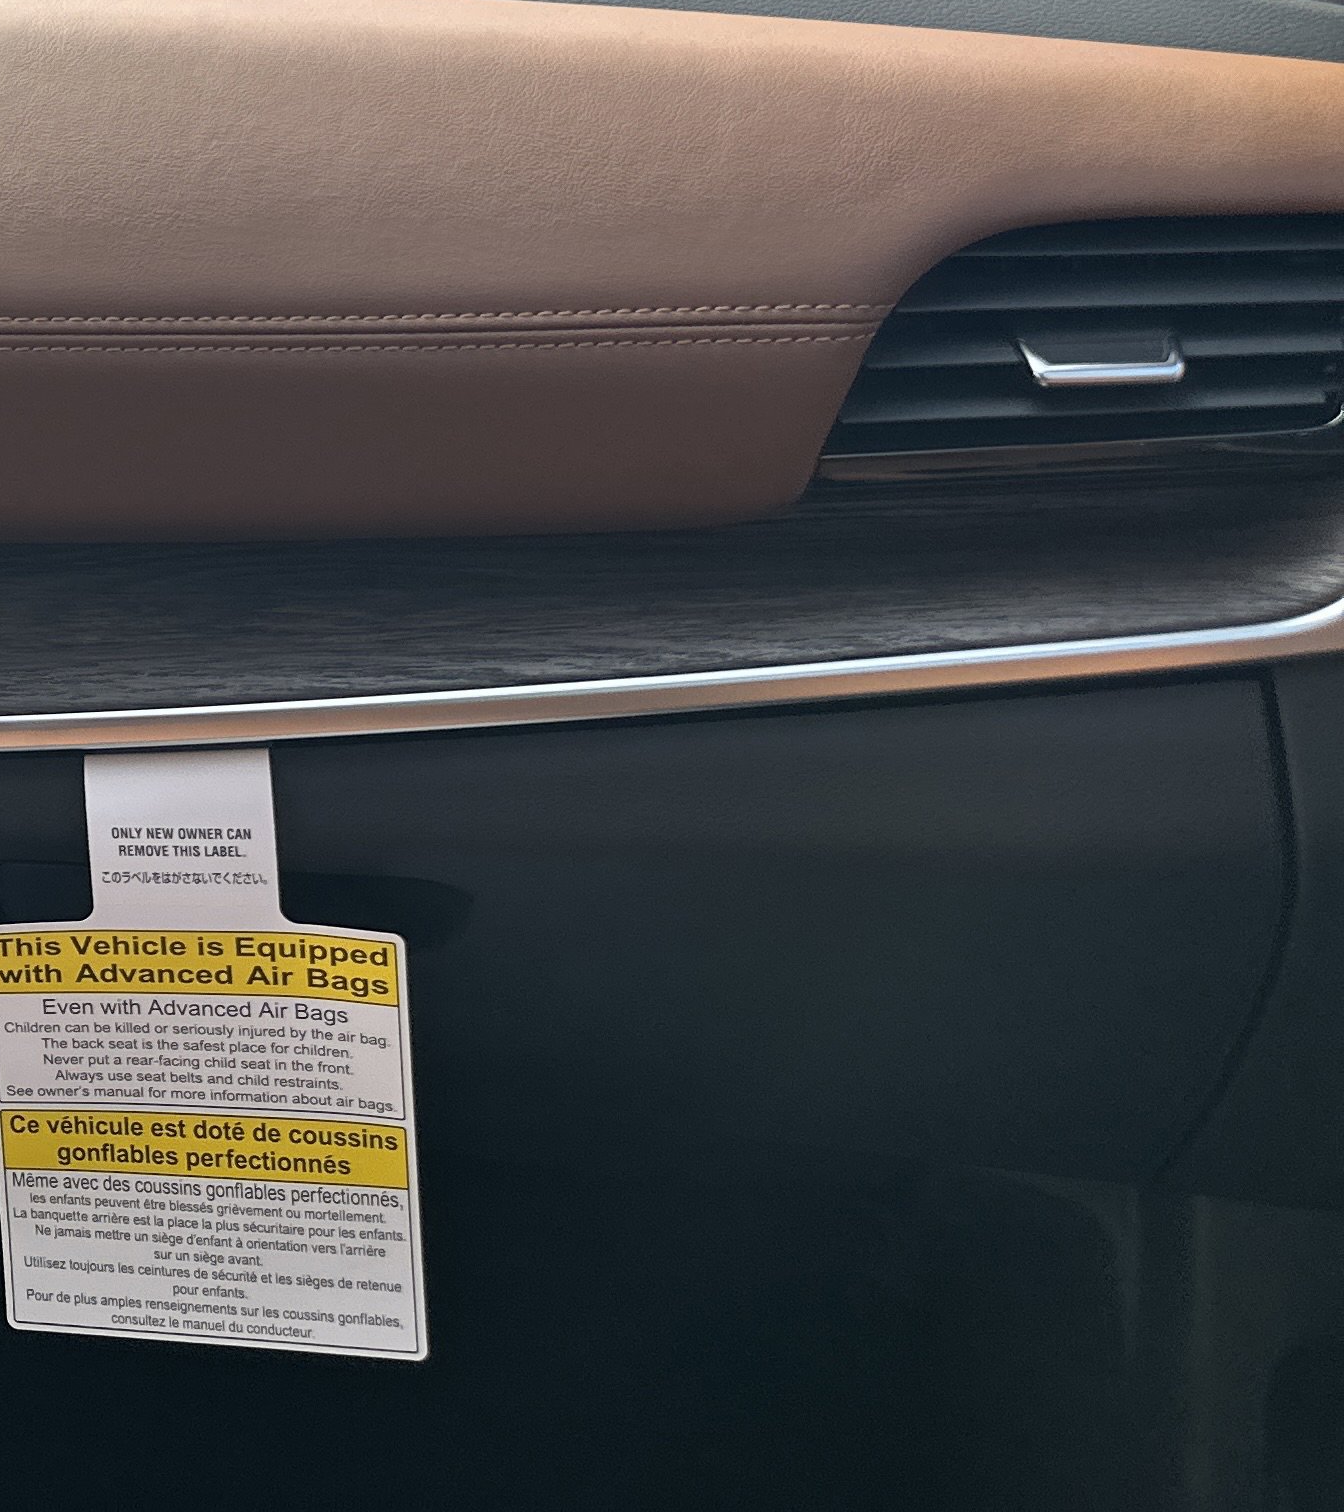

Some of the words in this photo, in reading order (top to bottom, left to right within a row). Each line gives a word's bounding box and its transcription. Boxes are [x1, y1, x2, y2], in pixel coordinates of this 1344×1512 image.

[112, 827, 142, 839] ONLY
[146, 828, 174, 840] NEW
[178, 828, 223, 840] OWNER
[227, 828, 251, 840] CAN
[119, 845, 168, 857] REMOVE
[173, 845, 200, 857] THIS
[204, 845, 246, 858] LABEL.
[102, 872, 268, 885] このラベルをはがさないでください。
[70, 936, 186, 956] Vehicle
[197, 938, 224, 957] is
[236, 938, 388, 967] Equipped
[76, 963, 233, 985] Advanced
[247, 966, 293, 986] Air
[307, 969, 389, 997] Bags
[43, 999, 94, 1016] Even
[101, 1000, 141, 1016] with
[148, 1000, 251, 1019] Advanced
[258, 1003, 288, 1019] Air
[295, 1005, 348, 1026] Bags
[4, 1022, 61, 1034] Children
[65, 1025, 88, 1034] can
[94, 1023, 111, 1034] be
[115, 1023, 149, 1035] killed
[154, 1026, 167, 1035] or
[172, 1024, 234, 1039] seriously
[238, 1026, 286, 1040] injured
[290, 1028, 307, 1041] by
[311, 1029, 333, 1041] the
[337, 1031, 356, 1043] air
[360, 1032, 391, 1049] bag.
[10, 1115, 40, 1134] Ce
[46, 1115, 144, 1137] véhicule
[151, 1119, 186, 1139] est
[193, 1119, 245, 1141] doté
[253, 1123, 281, 1142] de
[289, 1126, 398, 1150] coussins
[57, 1144, 178, 1166] gonflables
[186, 1148, 350, 1175] perfectionnés
[12, 1172, 58, 1188] Même
[63, 1177, 98, 1191] avec
[103, 1176, 130, 1192] des
[135, 1179, 200, 1196] coussins
[206, 1183, 285, 1201] gonflables
[291, 1187, 404, 1209] perfectionnés,
[154, 1250, 171, 1260] sur
[176, 1252, 189, 1261] un
[193, 1251, 224, 1266] siège
[228, 1254, 263, 1266] avant.
[112, 1313, 165, 1328] consultez
[169, 1316, 179, 1328] le
[183, 1317, 225, 1332] manuel
[229, 1321, 243, 1333] du
[247, 1323, 315, 1339] conducteur.
